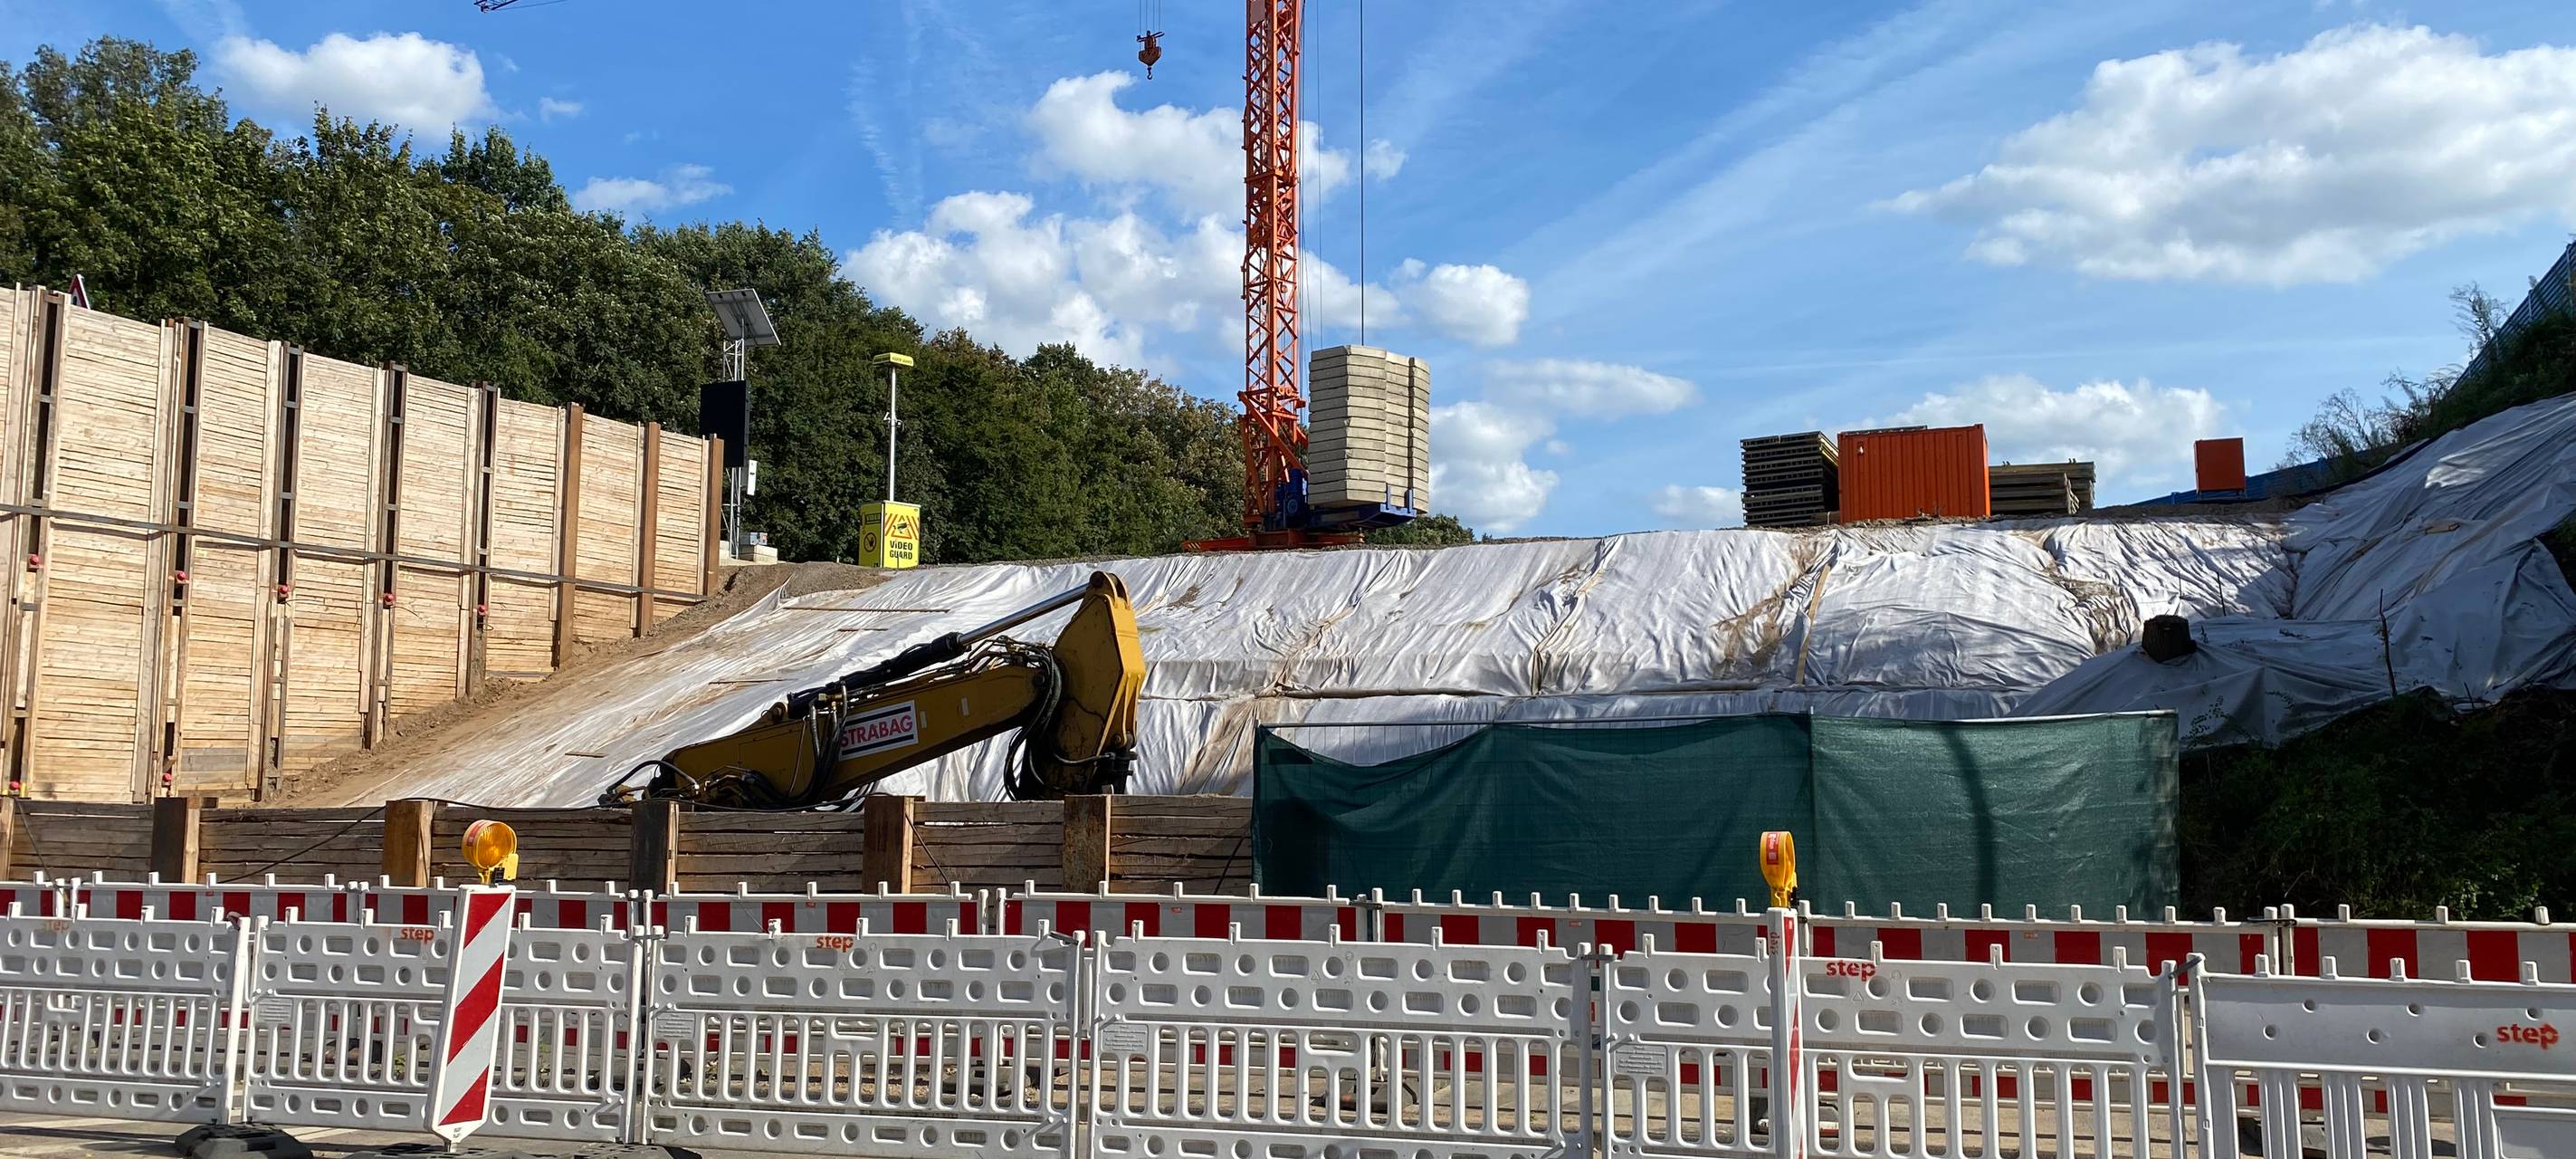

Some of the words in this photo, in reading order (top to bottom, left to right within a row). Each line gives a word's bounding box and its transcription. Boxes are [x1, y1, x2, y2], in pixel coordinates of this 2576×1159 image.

[889, 550, 913, 560] GUARD
[840, 714, 913, 747] STRABAG
[401, 927, 434, 944] step
[816, 935, 854, 953] step
[1826, 960, 1875, 982] step
[2496, 1023, 2559, 1049] step
